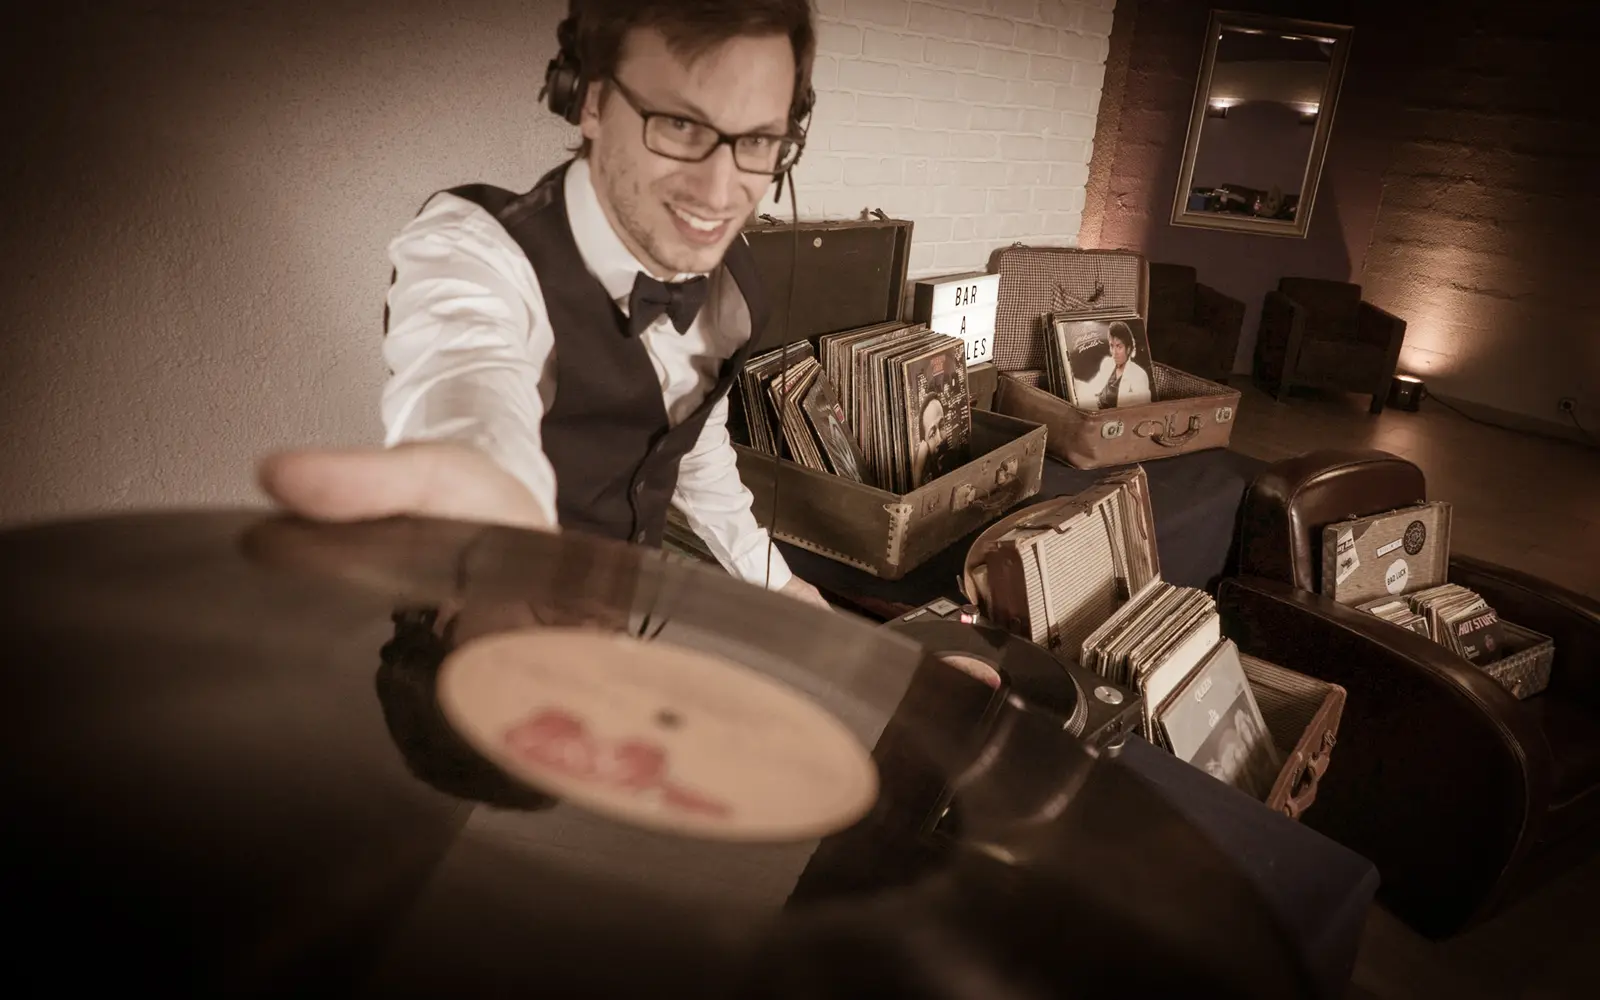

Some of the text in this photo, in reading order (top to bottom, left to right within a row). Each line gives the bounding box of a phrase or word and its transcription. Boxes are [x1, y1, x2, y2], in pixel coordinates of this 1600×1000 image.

[955, 285, 978, 306] BAR
[960, 315, 966, 334] A
[966, 337, 987, 361] LES
[1395, 568, 1406, 581] LUCK
[1458, 612, 1498, 636] HOT STUFF
